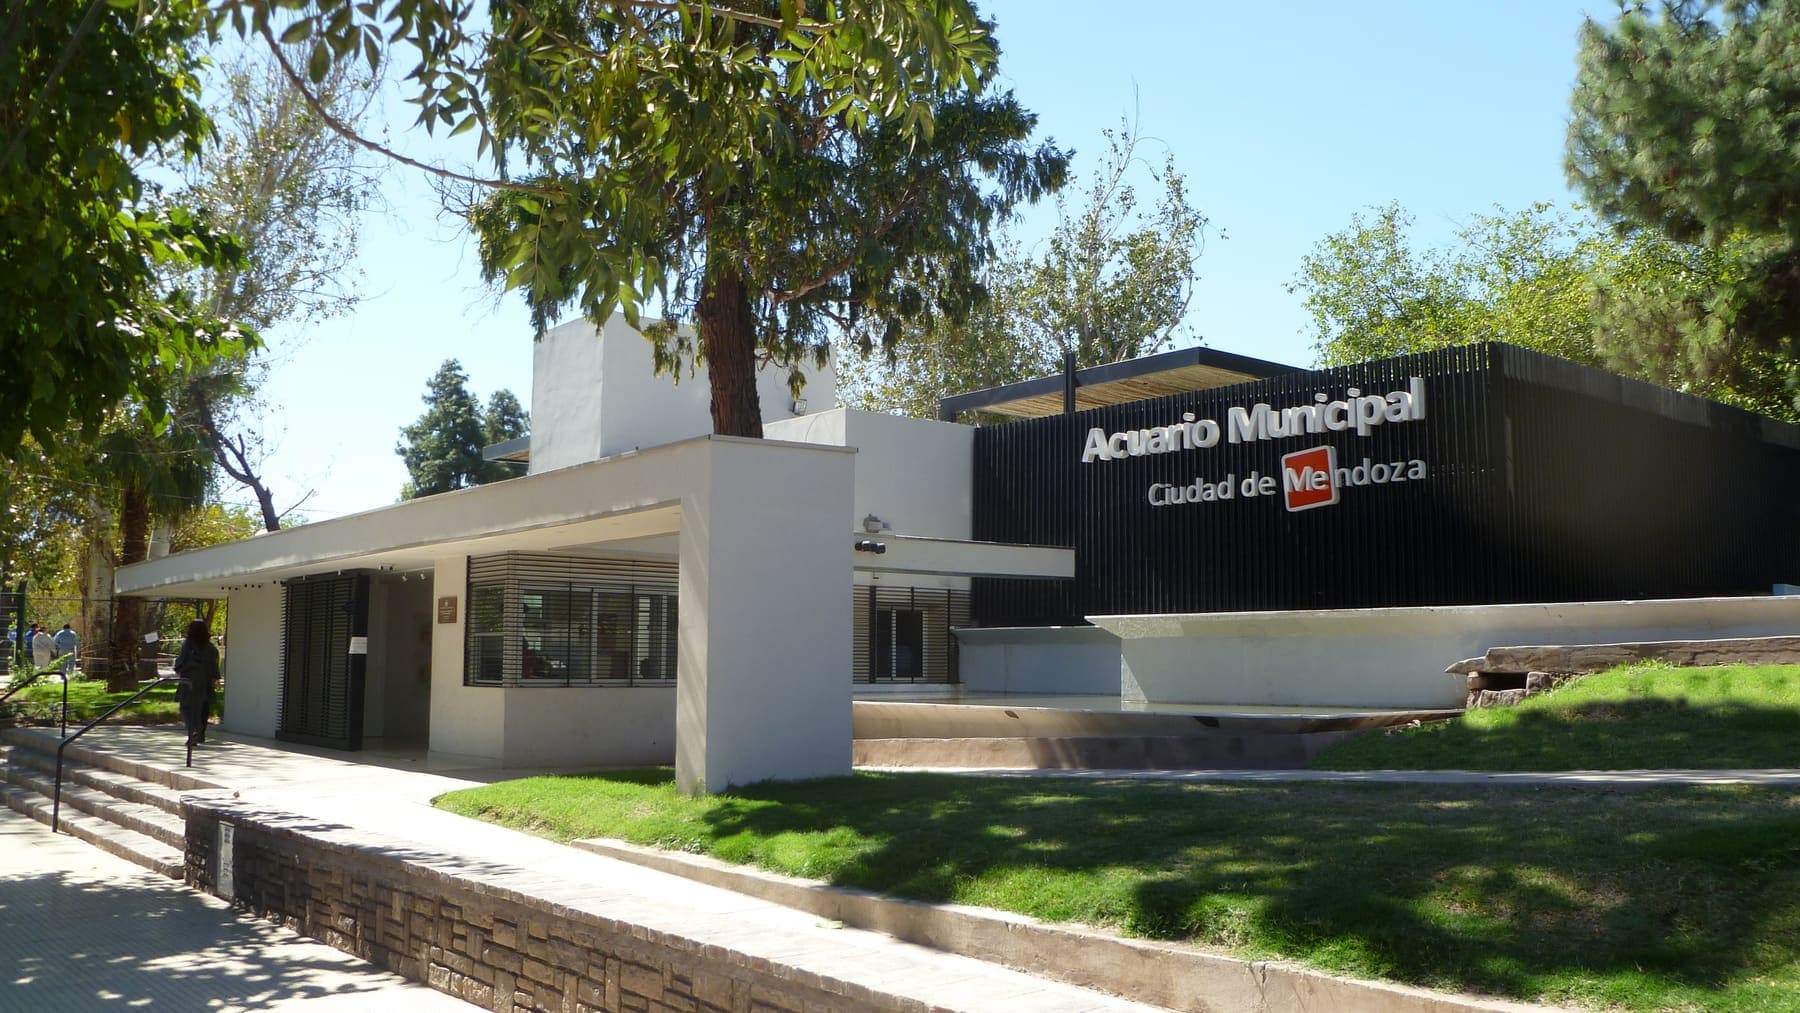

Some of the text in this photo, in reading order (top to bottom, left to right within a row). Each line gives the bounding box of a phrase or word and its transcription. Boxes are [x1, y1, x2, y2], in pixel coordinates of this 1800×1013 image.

[1082, 377, 1425, 463] Acuario Municipal
[1148, 458, 1427, 506] Ciudad de Mendoza
